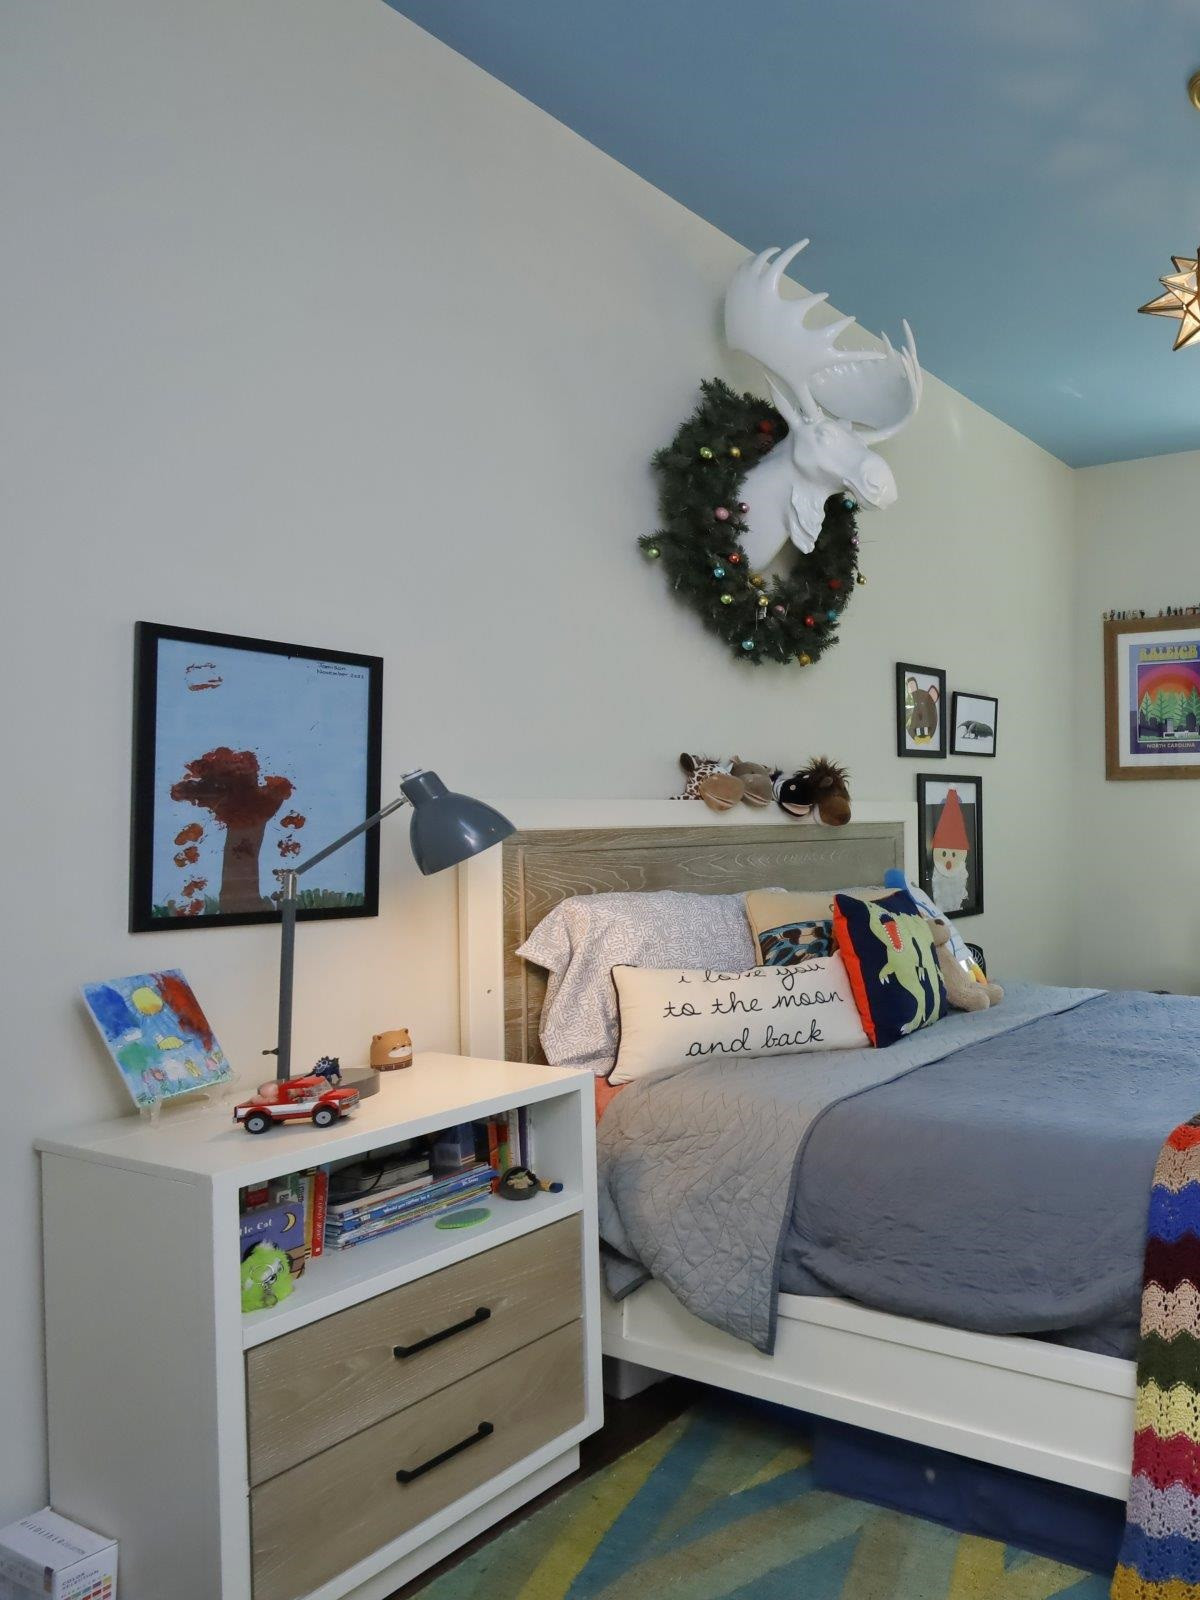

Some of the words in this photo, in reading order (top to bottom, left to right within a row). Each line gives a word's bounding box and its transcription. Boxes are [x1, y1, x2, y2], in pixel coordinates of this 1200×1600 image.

[1167, 741, 1195, 749] CAROLINA
[678, 971, 692, 984] i
[702, 965, 766, 983] love
[775, 963, 825, 991] you
[663, 1000, 702, 1018] to
[711, 991, 763, 1014] the
[771, 991, 844, 1009] moon
[685, 1027, 752, 1056] and
[760, 1019, 824, 1049] back
[257, 1218, 273, 1230] Cat
